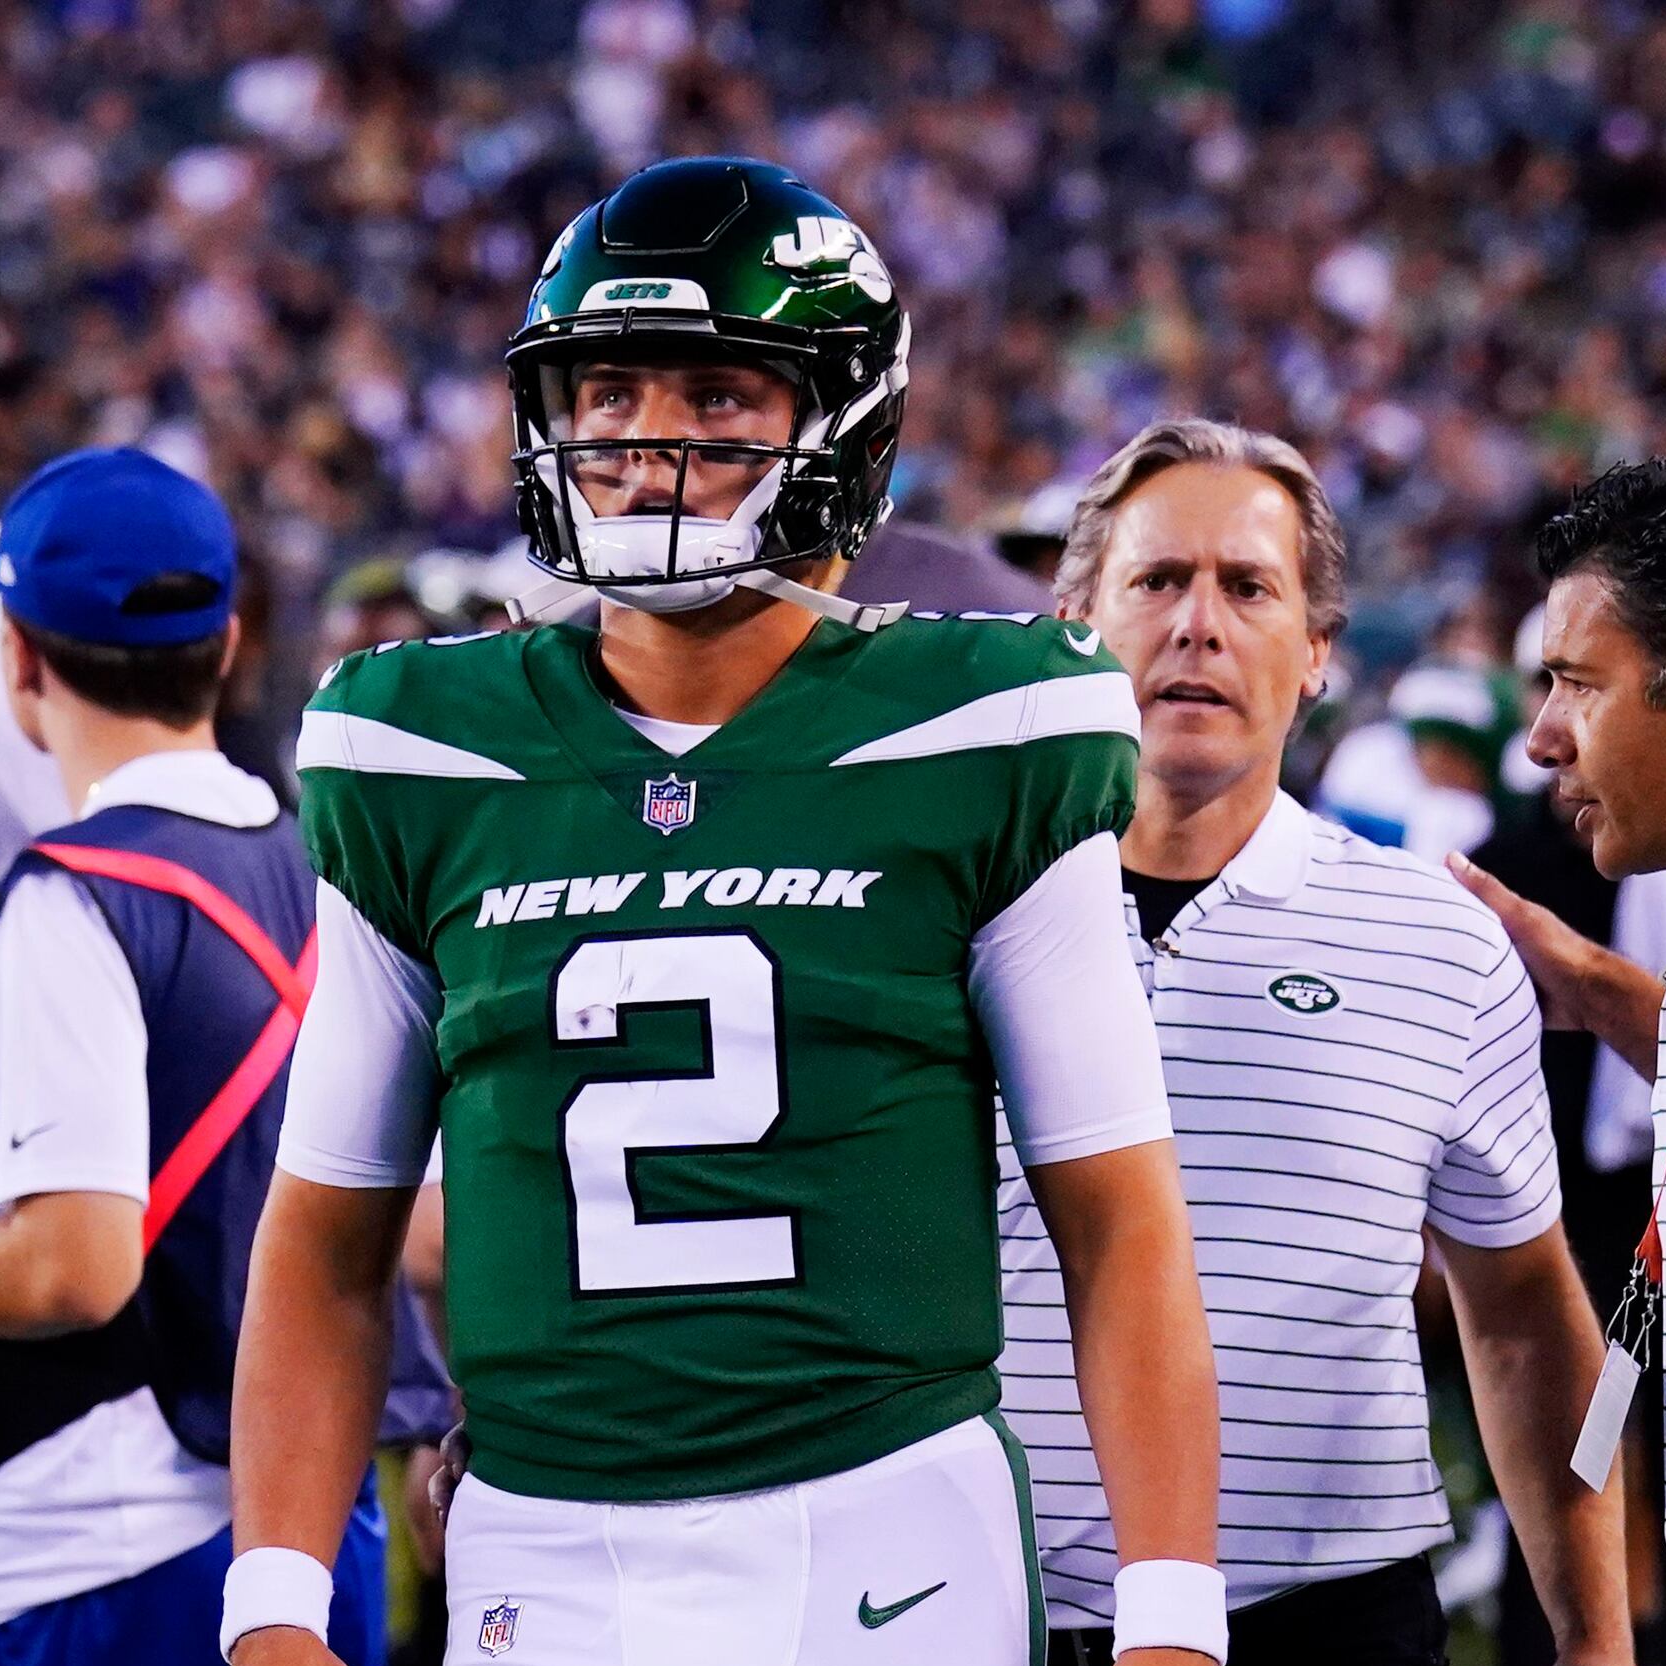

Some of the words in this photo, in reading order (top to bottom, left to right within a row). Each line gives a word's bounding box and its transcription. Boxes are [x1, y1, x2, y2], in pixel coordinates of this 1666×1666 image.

[604, 283, 672, 300] JETS
[652, 801, 684, 823] NFL
[474, 872, 648, 929] NEW
[659, 867, 883, 909] YORK
[551, 930, 799, 1298] 2
[483, 1624, 508, 1647] NFL
